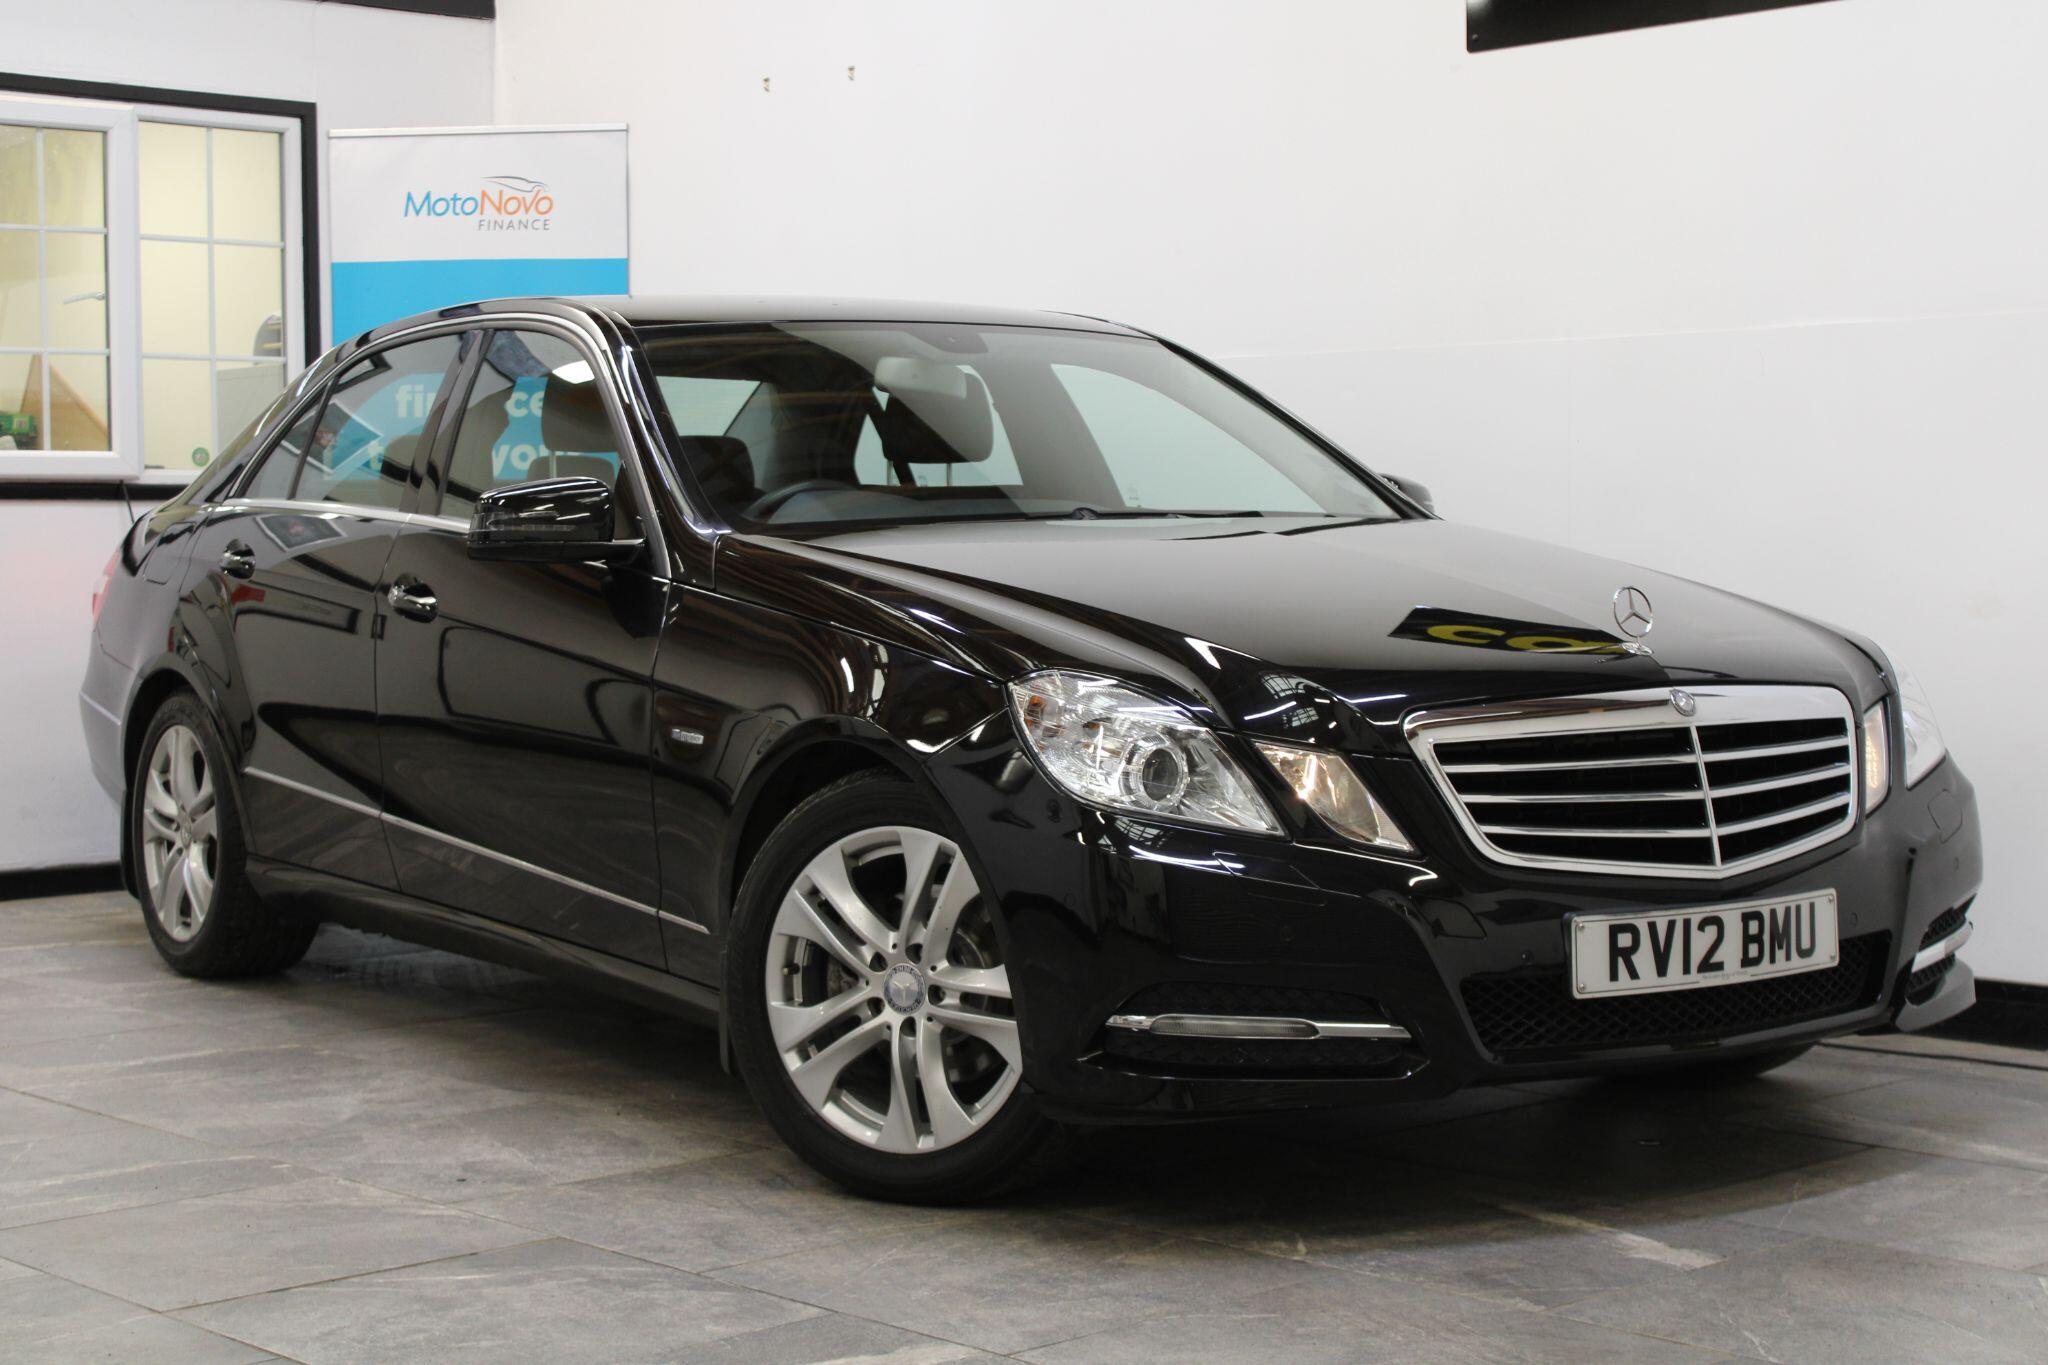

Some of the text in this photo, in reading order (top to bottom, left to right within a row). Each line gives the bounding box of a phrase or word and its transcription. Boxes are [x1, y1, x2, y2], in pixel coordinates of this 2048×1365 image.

[404, 189, 553, 217] MotoNovo
[478, 218, 551, 231] FINANCE
[1608, 902, 1816, 982] RV12 BMU
